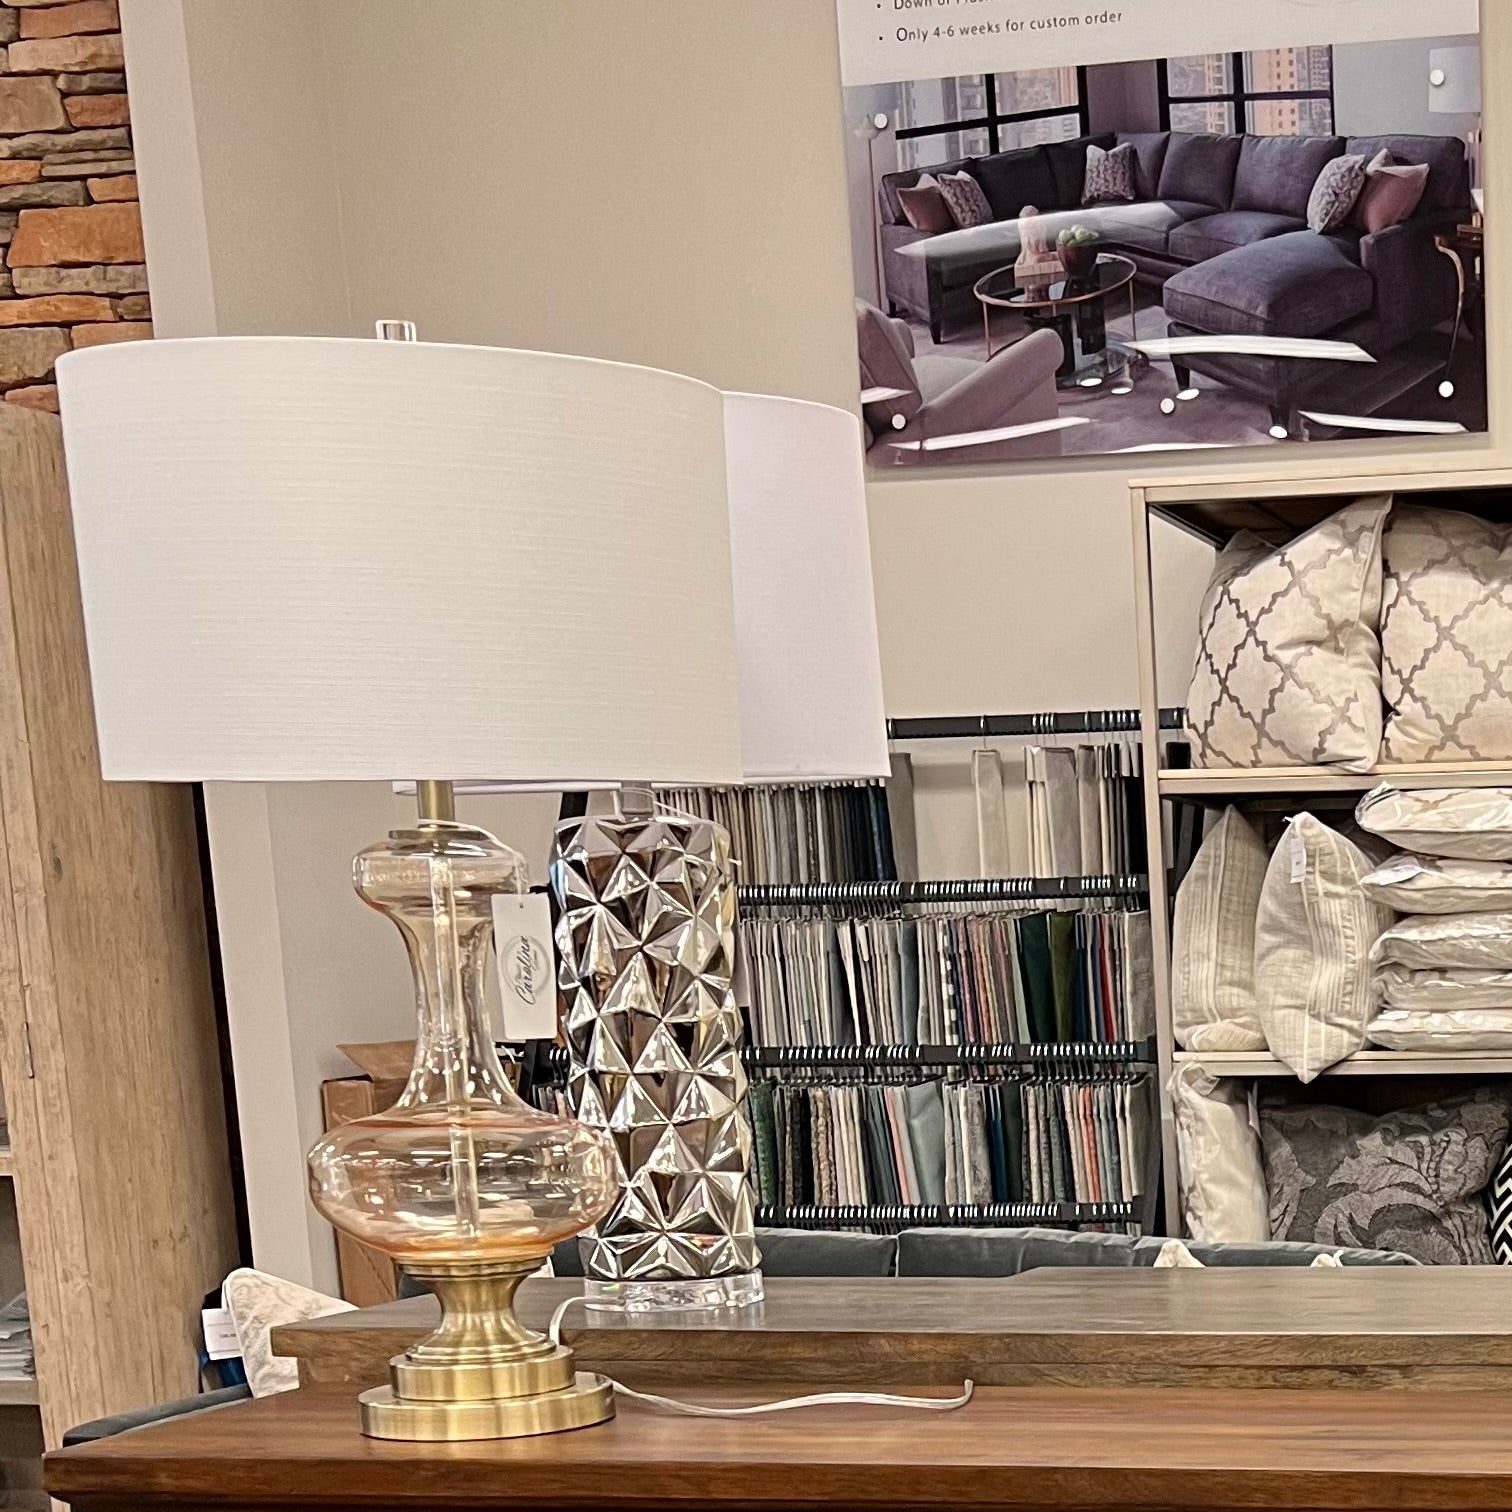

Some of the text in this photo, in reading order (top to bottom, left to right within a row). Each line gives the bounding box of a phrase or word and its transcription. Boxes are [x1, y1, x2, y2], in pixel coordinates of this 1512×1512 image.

[896, 10, 1122, 42] Only 4-6 weeks for custom order
[514, 935, 537, 1006] Carolina
